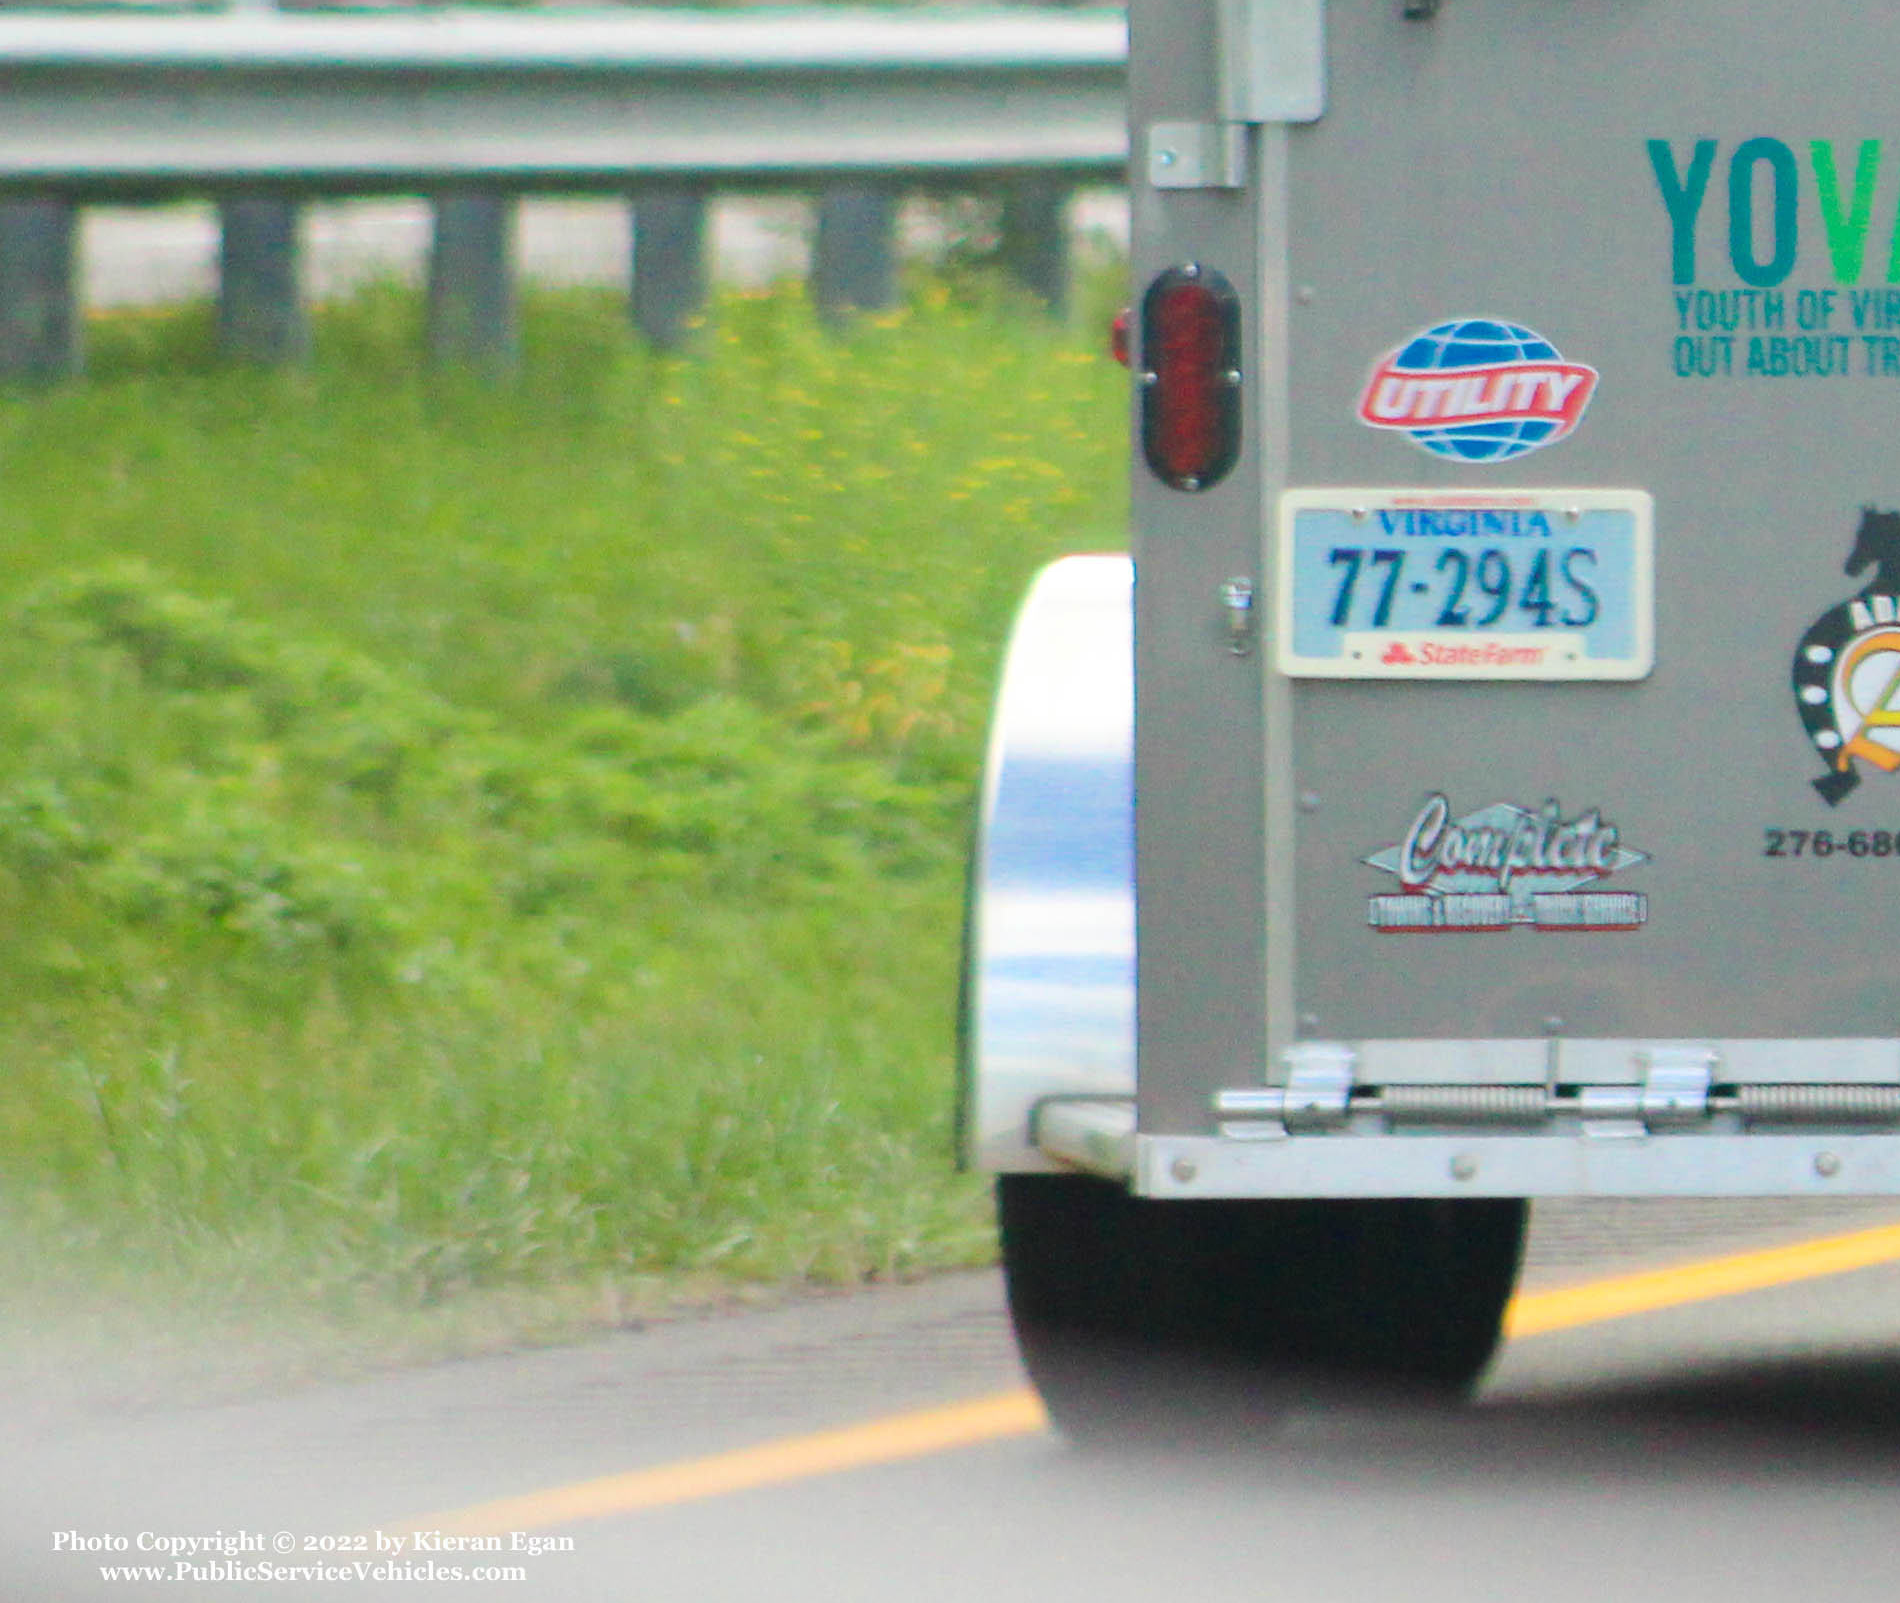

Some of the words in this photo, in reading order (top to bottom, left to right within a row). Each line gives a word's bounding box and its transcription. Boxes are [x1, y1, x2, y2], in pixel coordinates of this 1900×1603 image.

[1673, 289, 1786, 332] YOUTH
[1799, 289, 1838, 331] OF
[1672, 334, 1738, 377] OUT
[1746, 334, 1853, 376] ABOUT
[1373, 370, 1583, 420] UTILITY
[1373, 508, 1553, 538] VIRGINIA
[1328, 546, 1600, 630] 77-294S
[1400, 792, 1620, 892] Complete
